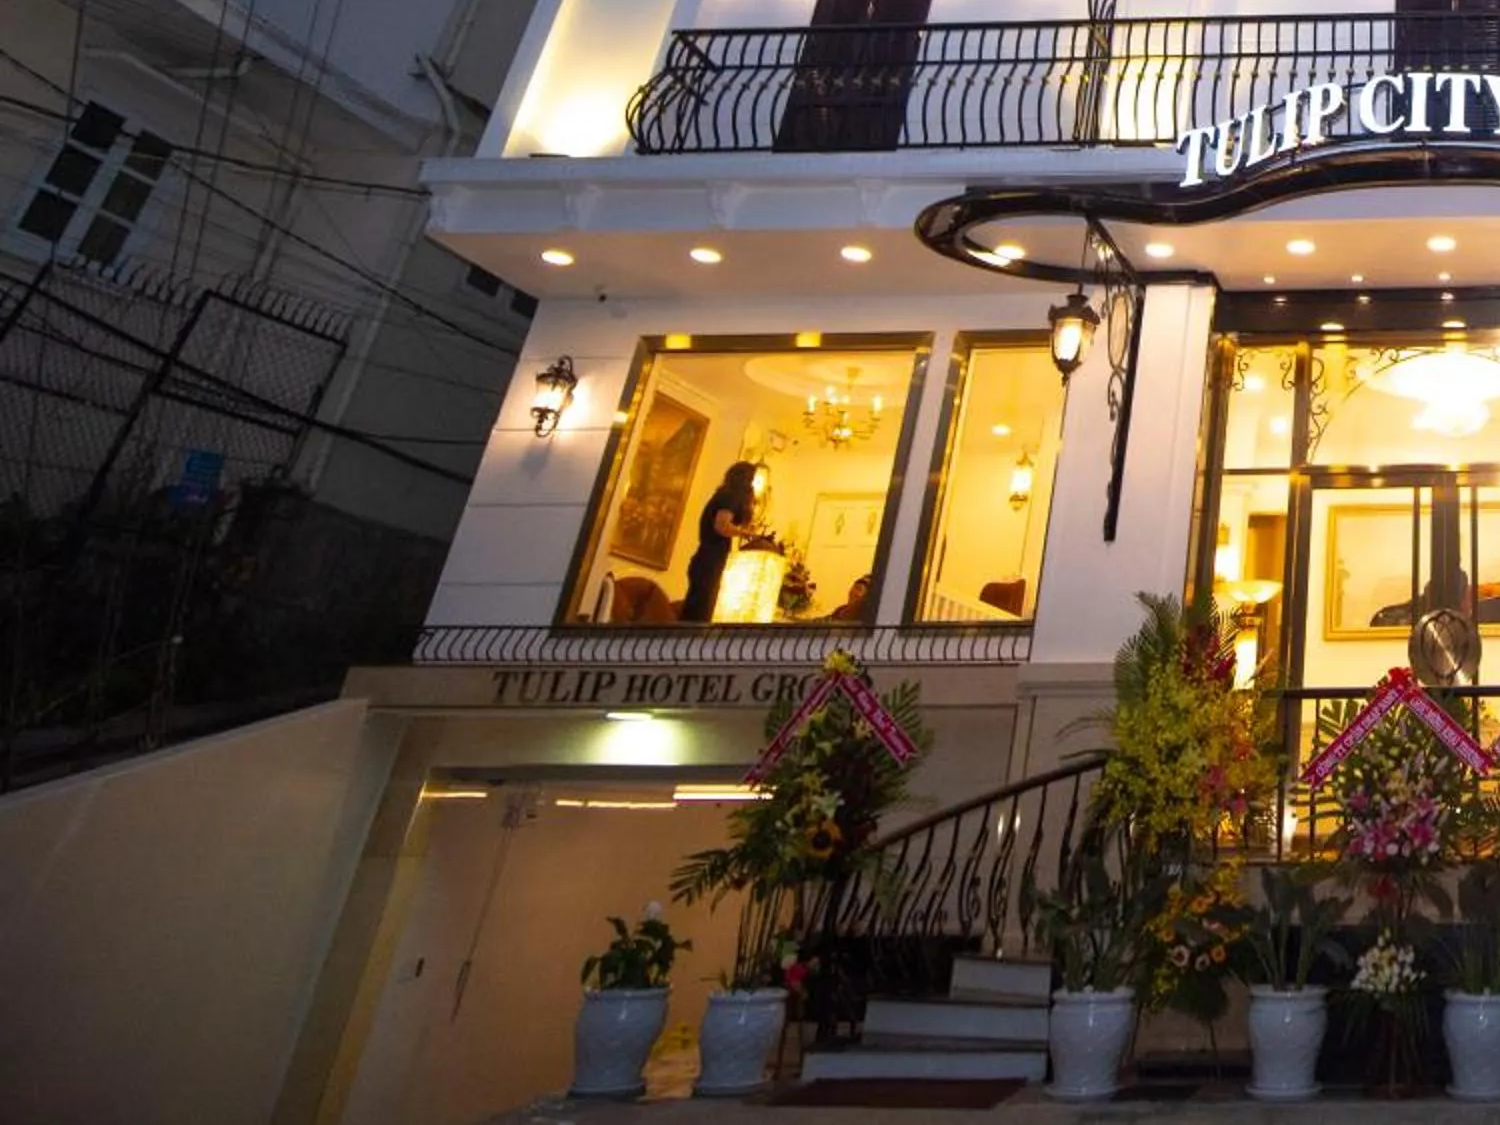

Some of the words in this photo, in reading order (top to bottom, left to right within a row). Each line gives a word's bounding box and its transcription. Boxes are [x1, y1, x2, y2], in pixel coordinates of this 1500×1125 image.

[1176, 81, 1345, 188] TULIP
[491, 670, 618, 704] TULIP
[621, 672, 743, 704] HOTEL
